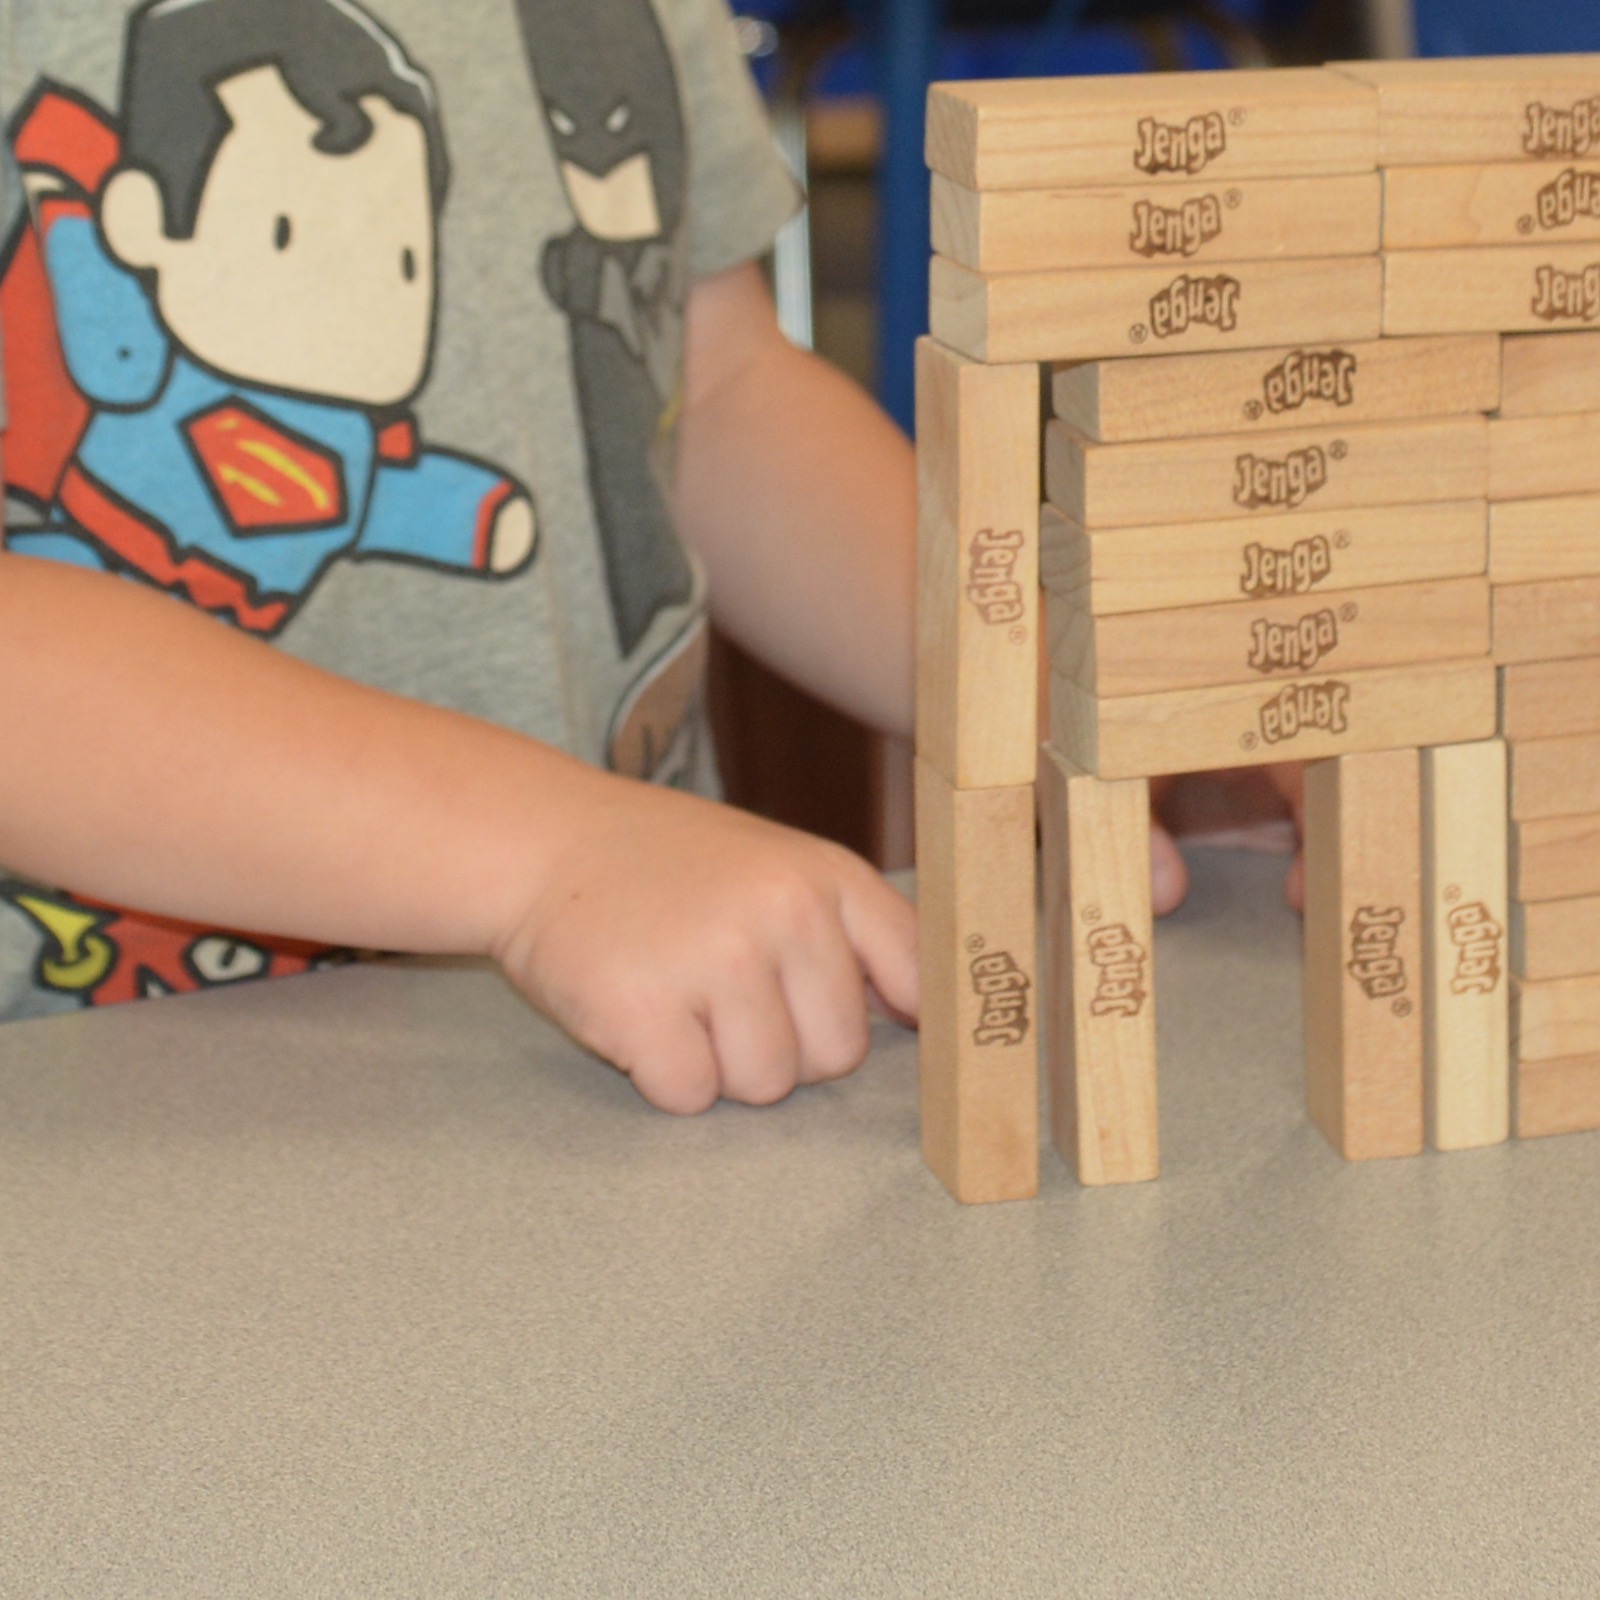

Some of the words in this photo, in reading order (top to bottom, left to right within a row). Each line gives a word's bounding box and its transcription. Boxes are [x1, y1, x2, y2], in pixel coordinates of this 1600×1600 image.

[1134, 111, 1225, 174] Jenga
[1129, 194, 1221, 257] Jenga
[1233, 445, 1325, 508] Jenga
[1241, 535, 1329, 596] Jenga
[1248, 609, 1337, 672] Jenga
